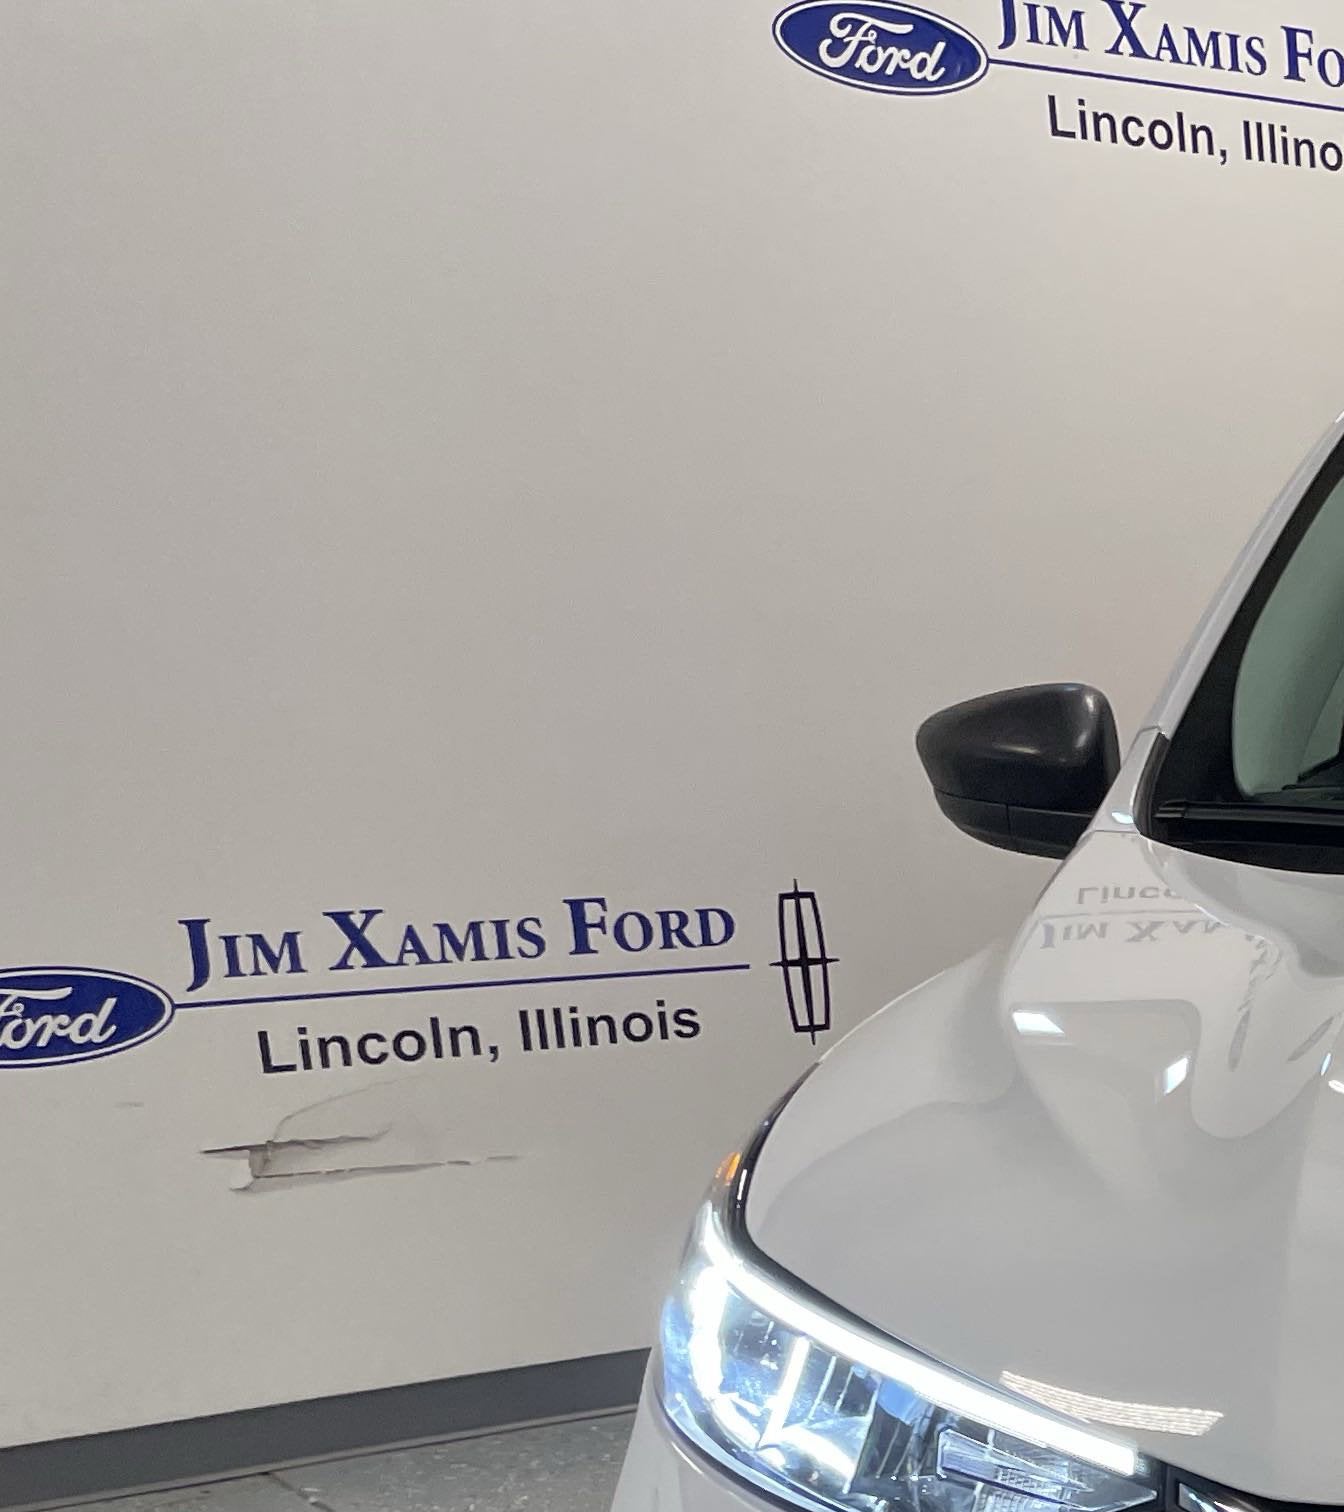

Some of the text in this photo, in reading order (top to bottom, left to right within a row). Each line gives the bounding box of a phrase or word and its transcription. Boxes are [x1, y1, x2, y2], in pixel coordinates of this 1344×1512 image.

[817, 11, 946, 84] Ford
[998, 0, 1089, 51] JIM
[1103, 2, 1267, 77] XAMIS
[1047, 94, 1227, 166] Lincoln,
[177, 897, 736, 993] JIM XAMIS FORD
[257, 1000, 702, 1075] Lincoln, Illinois
